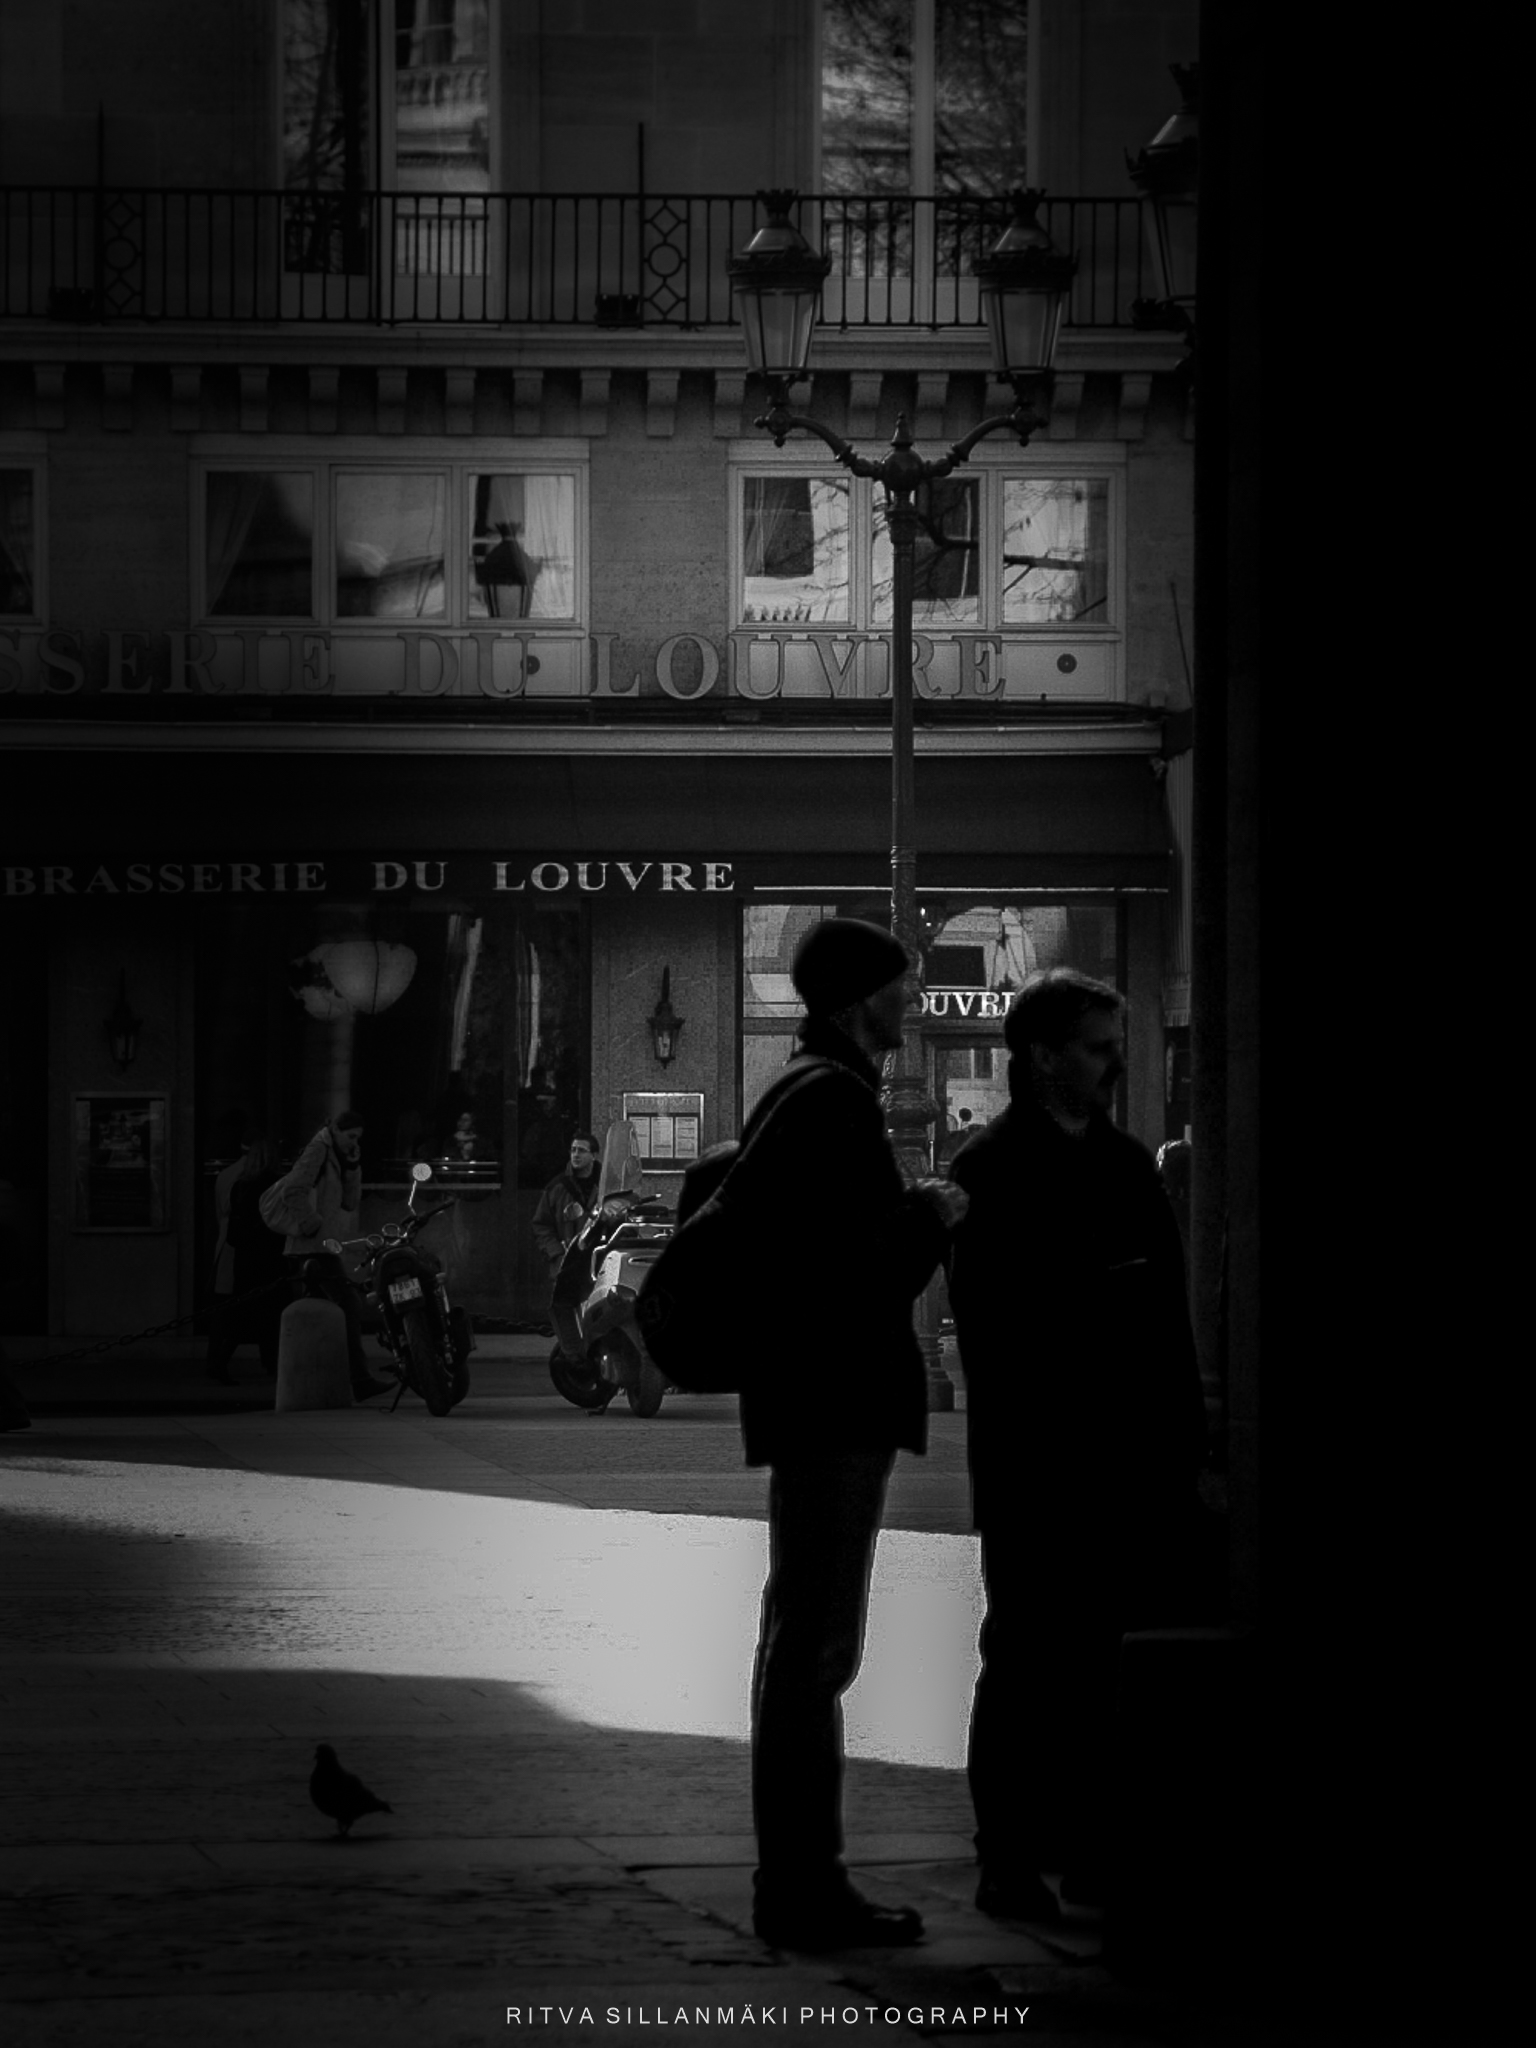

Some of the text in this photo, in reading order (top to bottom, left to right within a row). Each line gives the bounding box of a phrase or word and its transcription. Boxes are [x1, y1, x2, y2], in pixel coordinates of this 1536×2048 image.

[396, 632, 536, 699] DU
[588, 633, 1006, 700] LOUVRE
[2, 861, 736, 896] BRASSERIE DU LOUVRE
